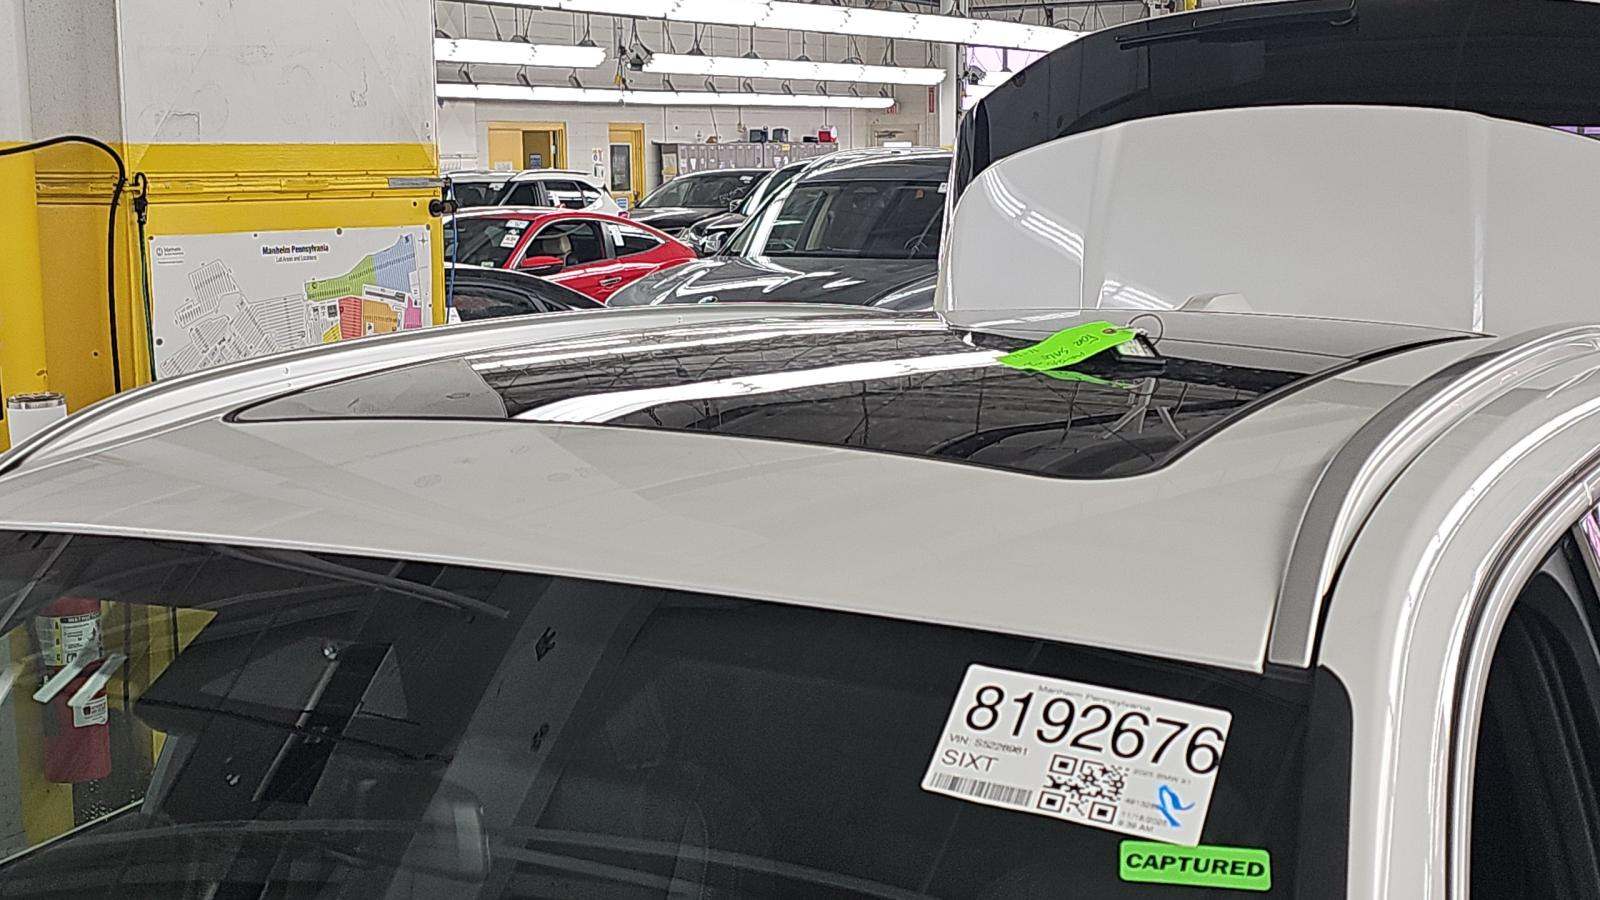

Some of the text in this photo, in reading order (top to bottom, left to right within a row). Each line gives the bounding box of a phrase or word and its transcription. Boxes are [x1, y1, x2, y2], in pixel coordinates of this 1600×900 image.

[262, 243, 329, 254] Manheim Pennsylvania
[1037, 684, 1151, 711] Manheim Pennsylvania
[966, 685, 1225, 774] 8192676
[941, 749, 999, 771] SIXT
[1126, 853, 1265, 877] CAPTURED
